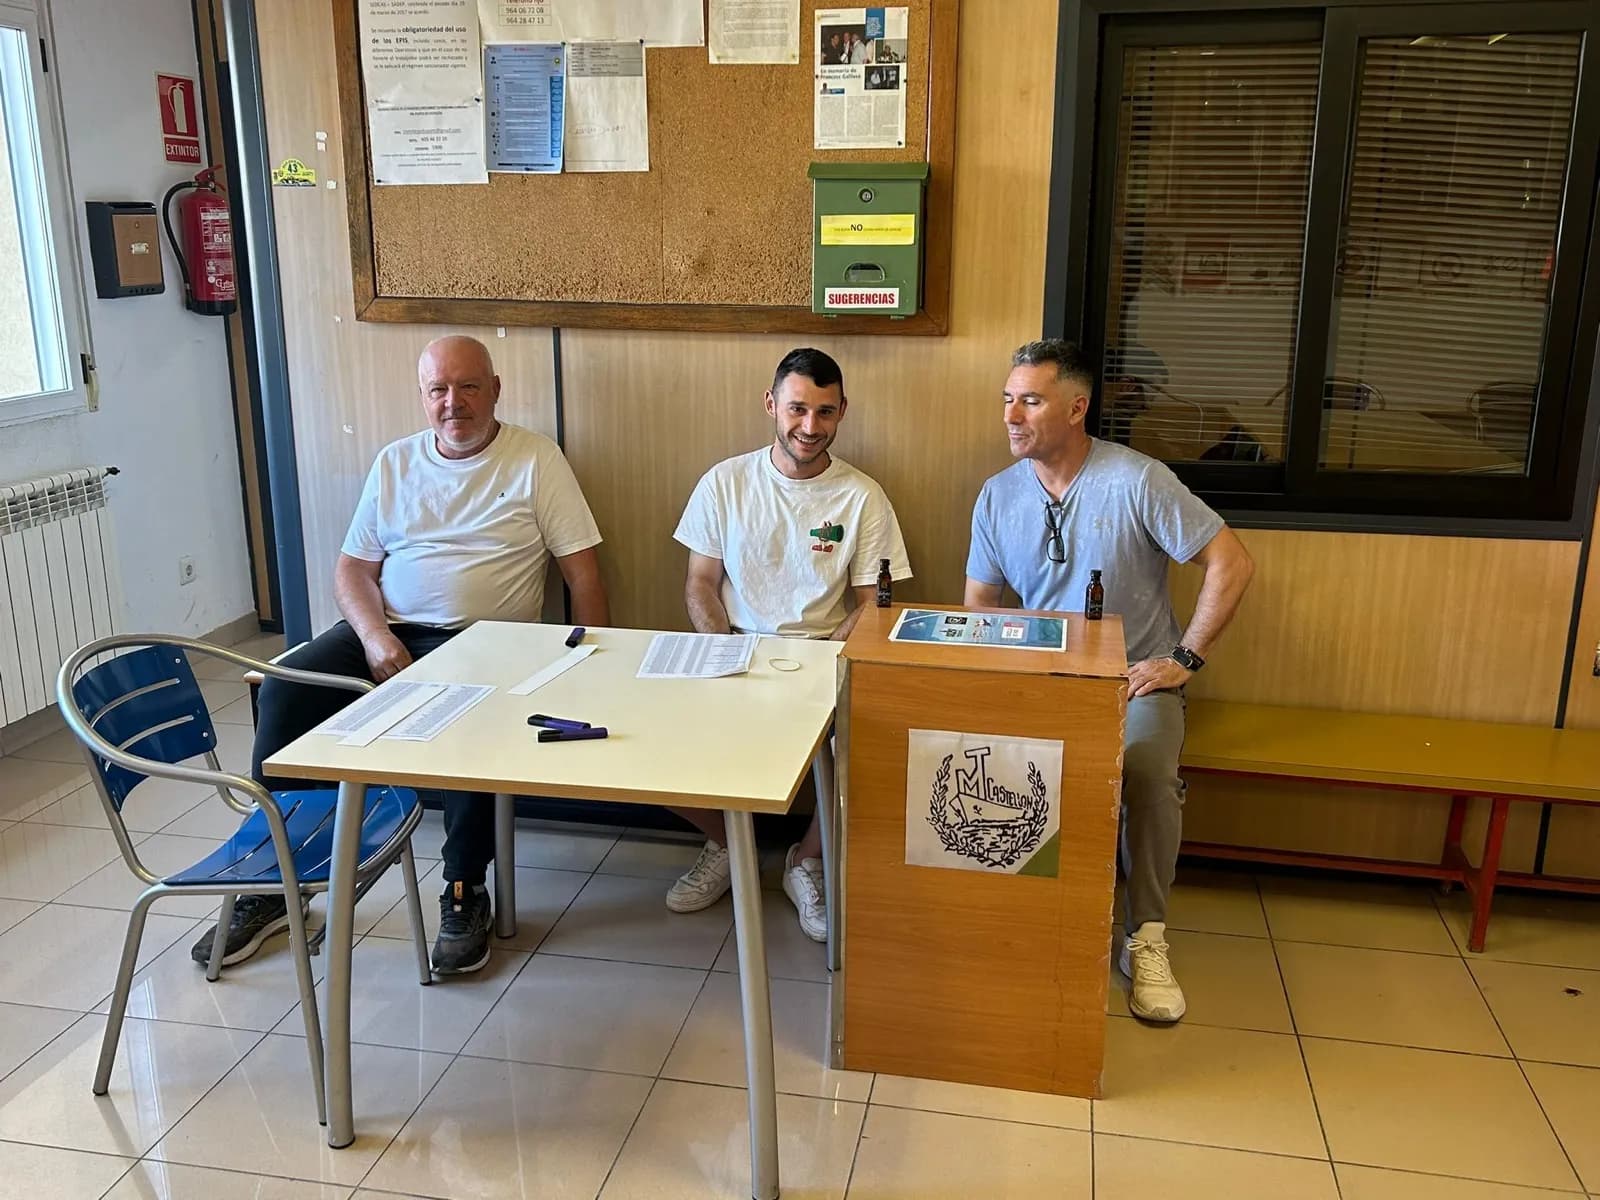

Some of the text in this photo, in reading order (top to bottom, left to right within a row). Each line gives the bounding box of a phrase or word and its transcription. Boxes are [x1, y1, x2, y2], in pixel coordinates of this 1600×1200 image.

[166, 144, 199, 157] EXTINTOR
[288, 164, 298, 173] 43
[828, 293, 894, 304] SUGERENCIAS
